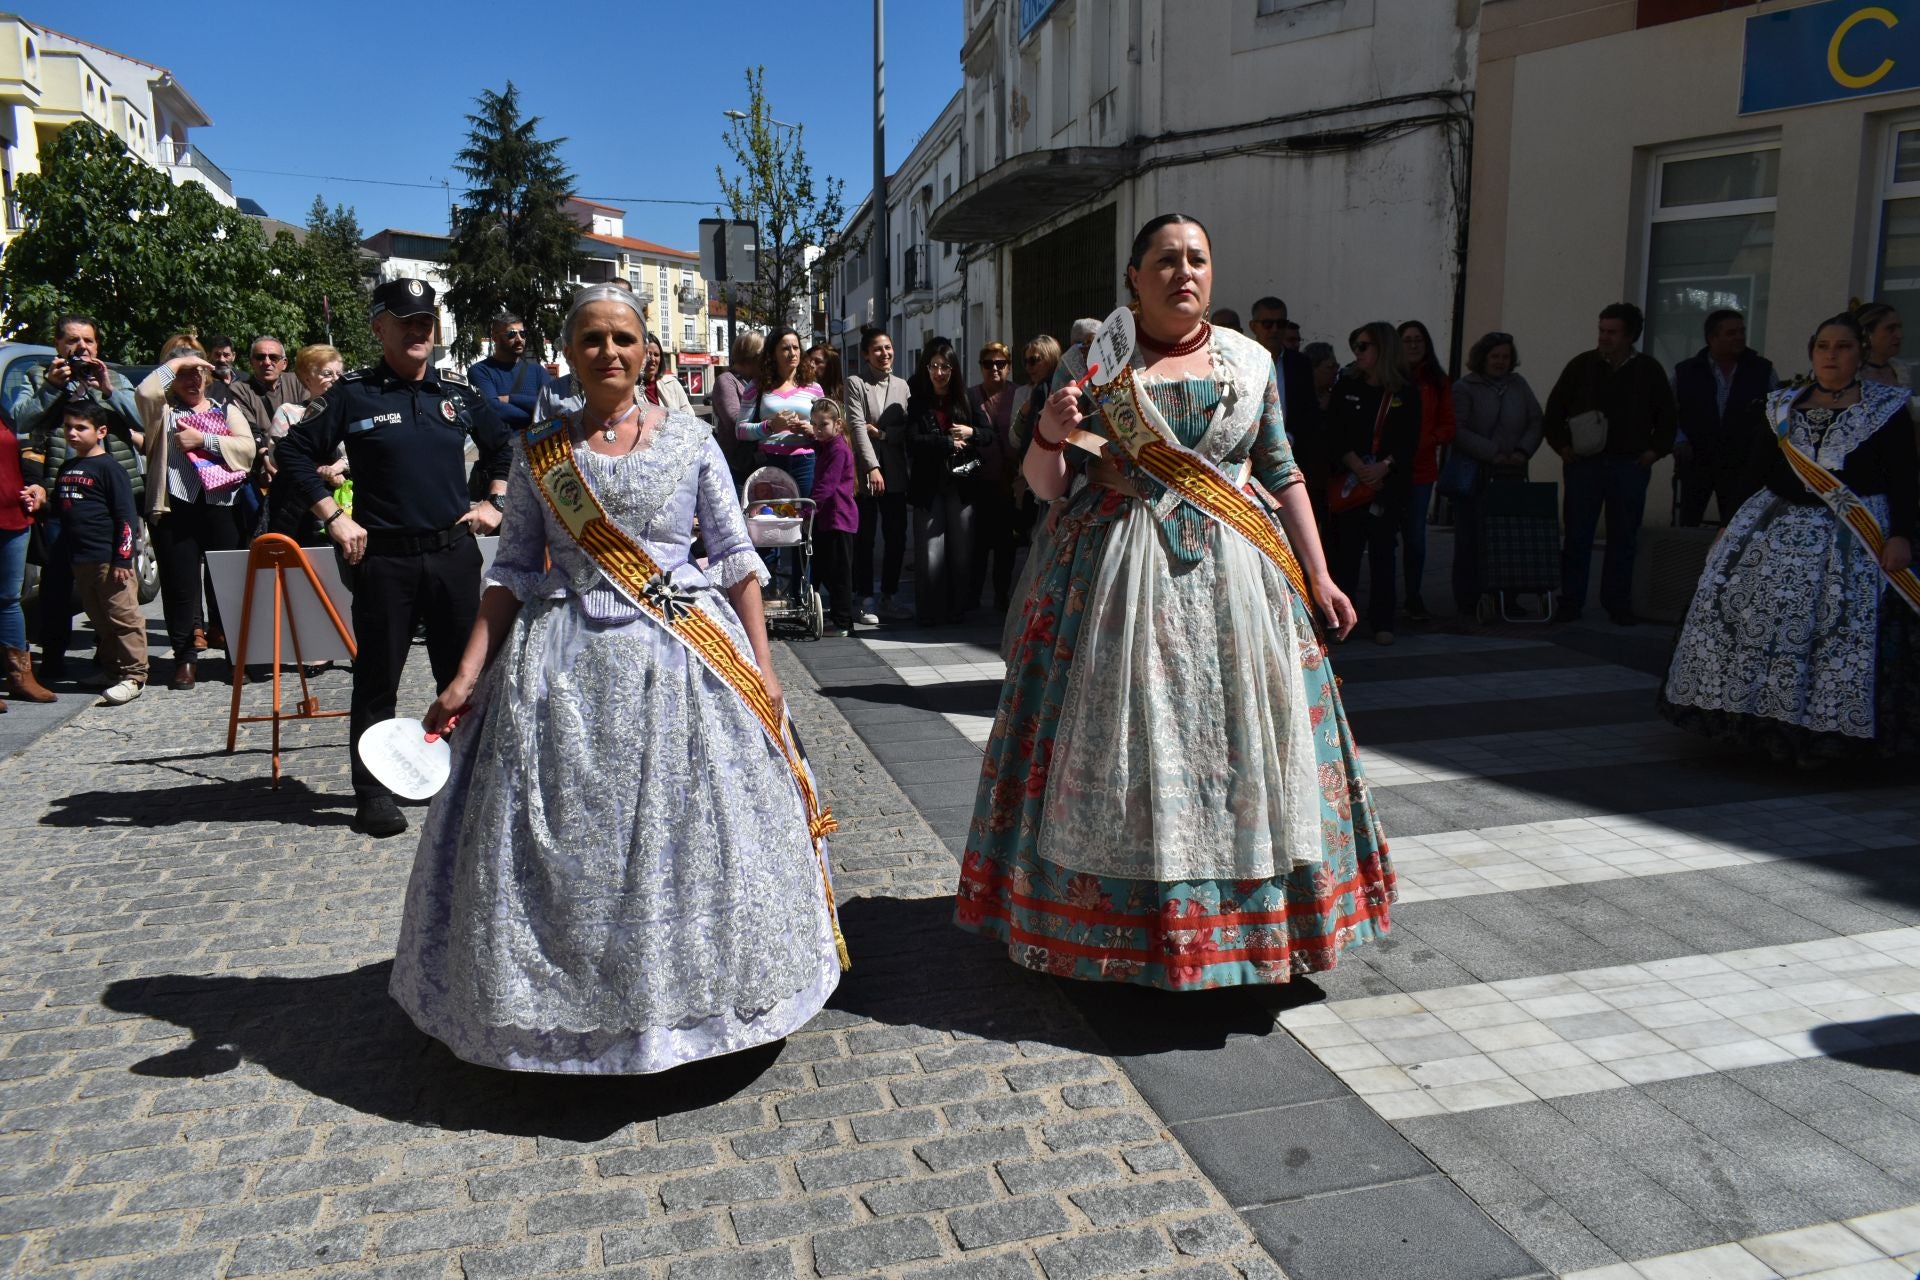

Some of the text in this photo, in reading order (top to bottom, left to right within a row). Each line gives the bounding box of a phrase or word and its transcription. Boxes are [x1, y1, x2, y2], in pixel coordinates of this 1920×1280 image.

[1827, 6, 1899, 89] C
[1110, 333, 1124, 366] MODA
[1114, 314, 1130, 357] MIAJADAS
[373, 412, 402, 424] POLICIA
